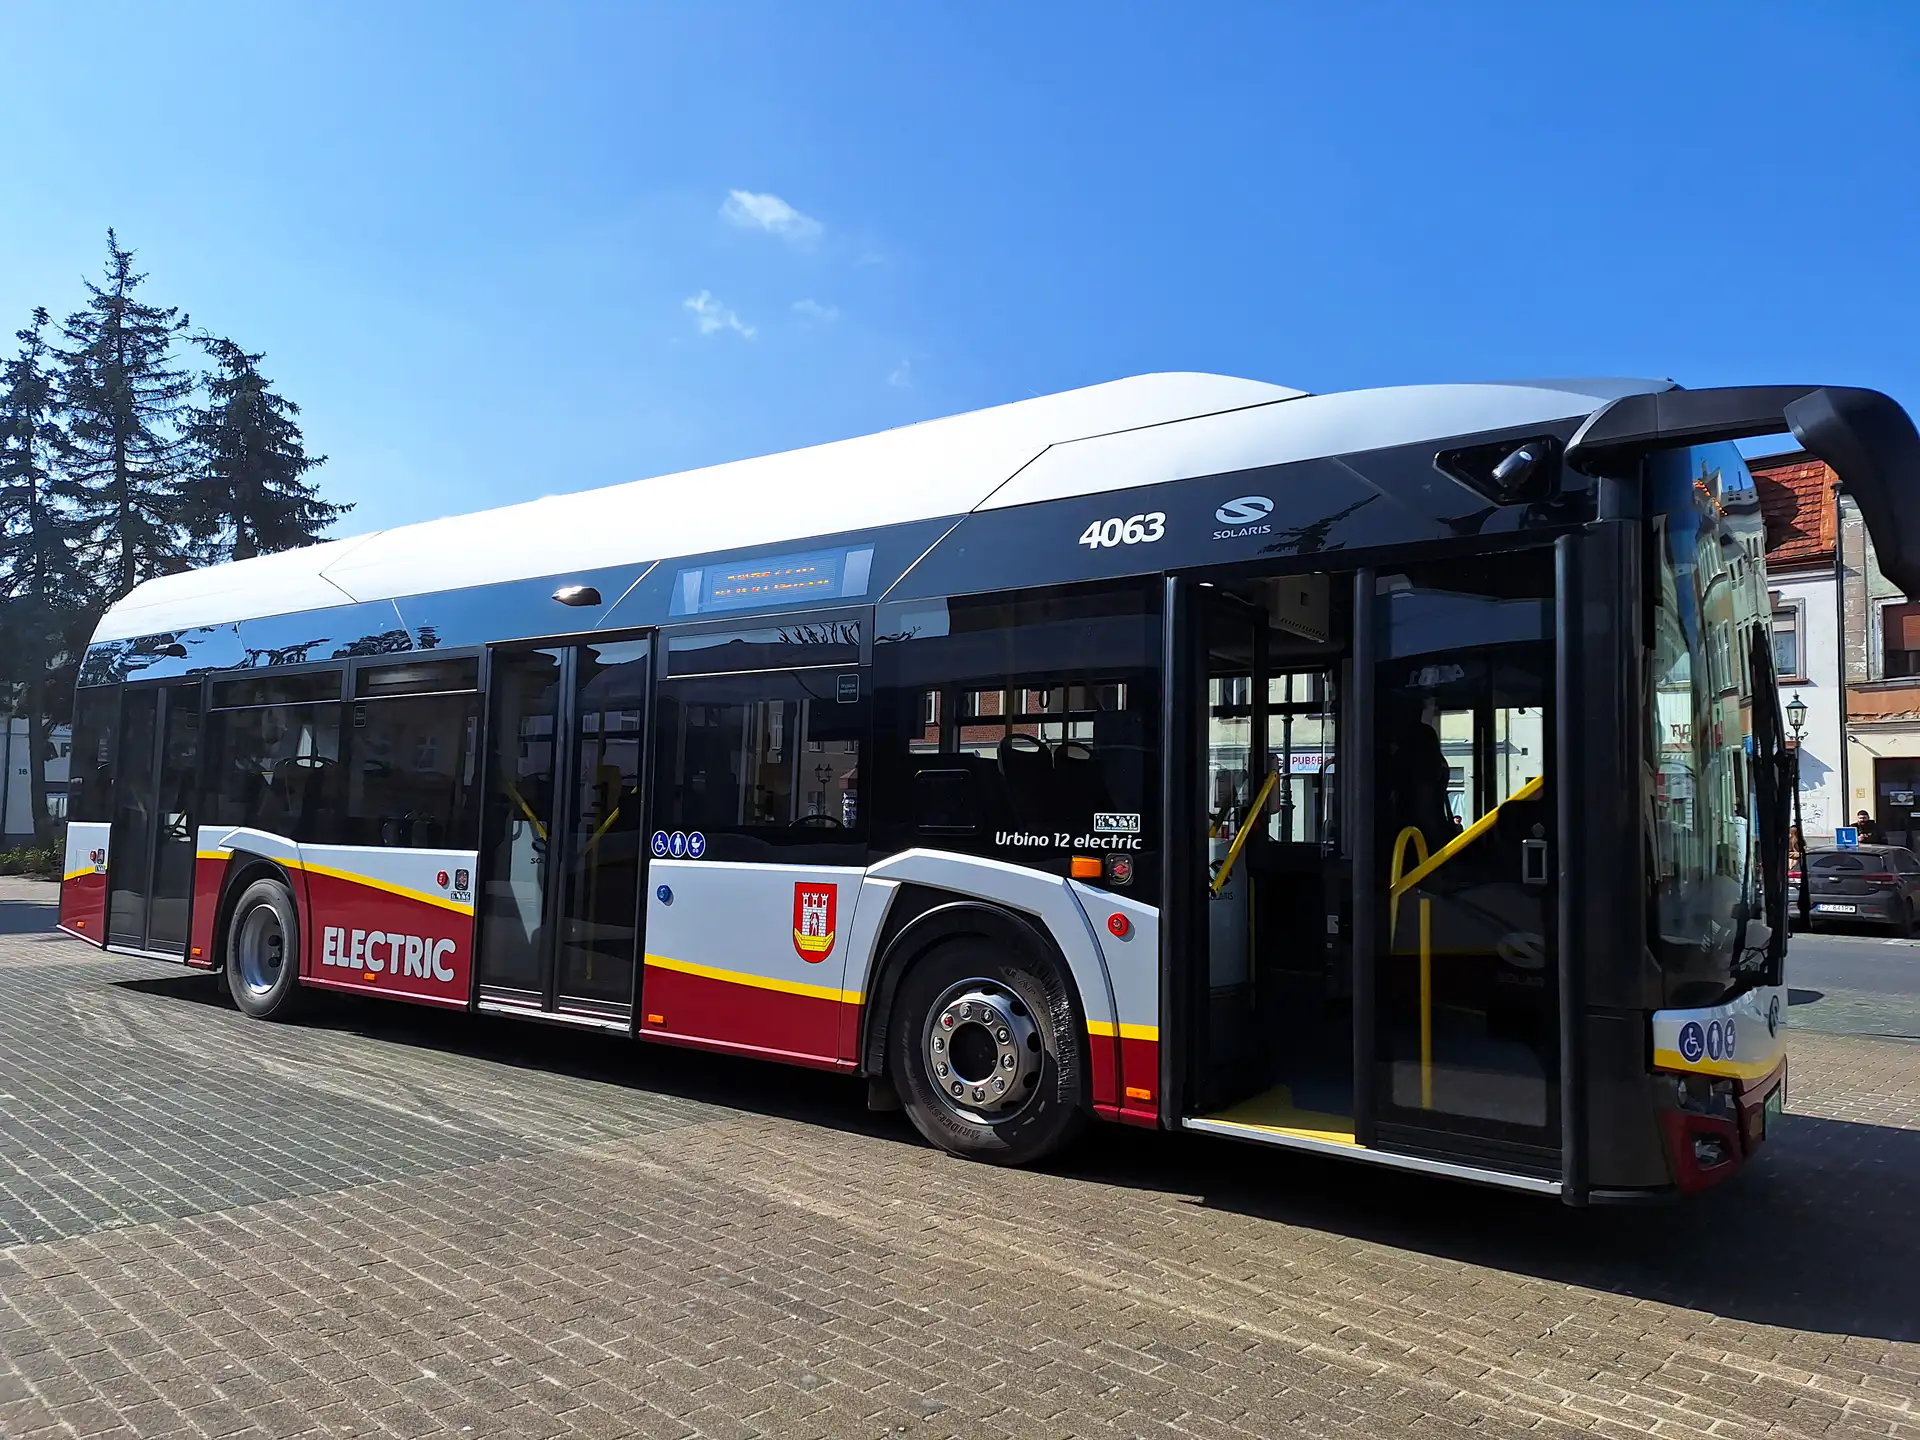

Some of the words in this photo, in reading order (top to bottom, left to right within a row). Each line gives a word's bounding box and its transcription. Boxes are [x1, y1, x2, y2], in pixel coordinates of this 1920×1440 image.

[1079, 511, 1167, 549] 4063
[1212, 524, 1271, 540] SOLARIS
[18, 768, 28, 776] 16
[995, 831, 1049, 847] Urbino
[1054, 833, 1070, 848] 12
[1073, 834, 1142, 850] electric
[1842, 830, 1853, 843] L
[322, 926, 456, 982] ELECTRIC
